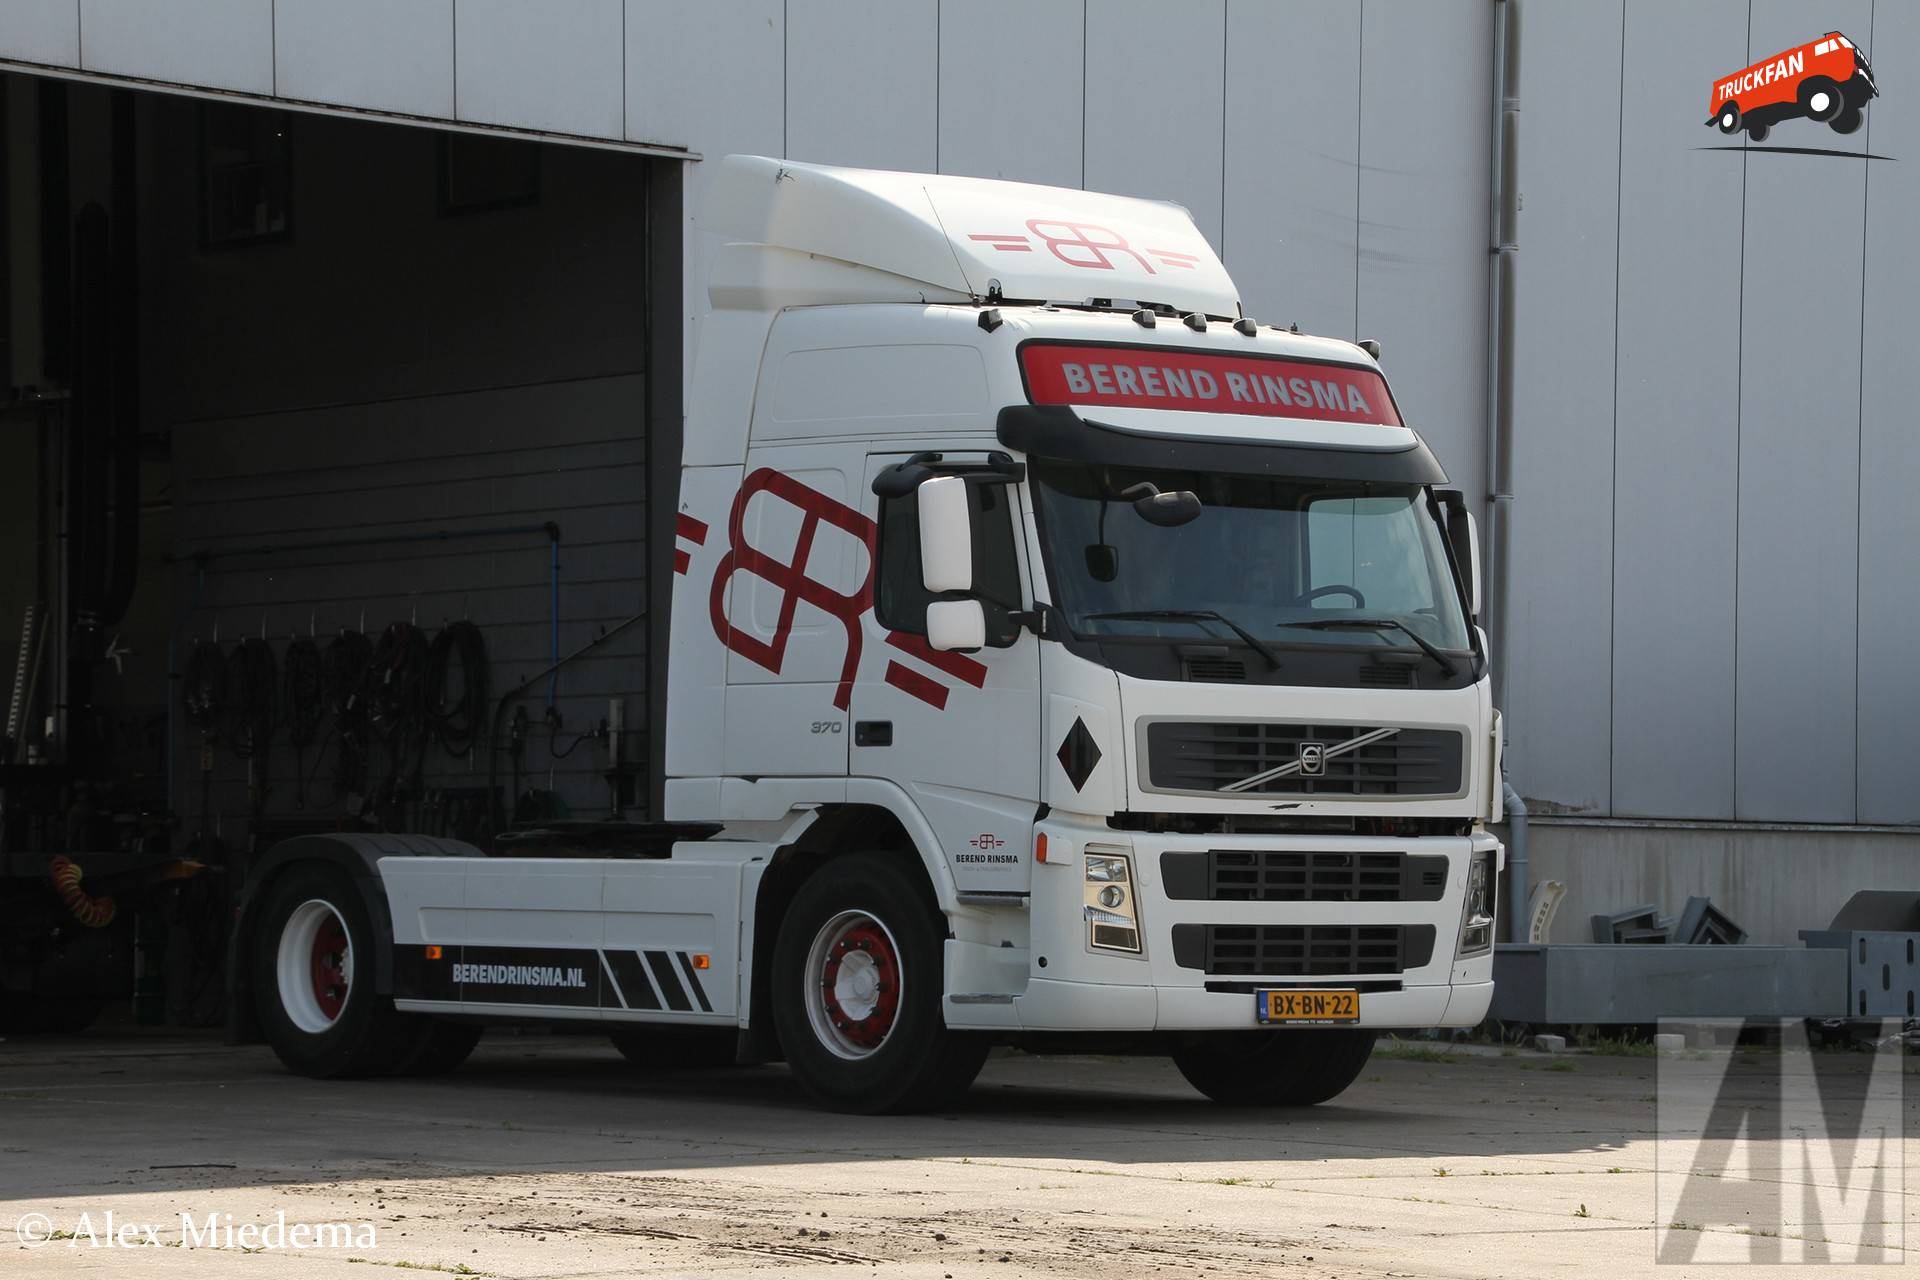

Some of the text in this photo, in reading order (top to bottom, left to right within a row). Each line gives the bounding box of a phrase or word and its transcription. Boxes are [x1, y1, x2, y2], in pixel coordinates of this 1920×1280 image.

[1062, 362, 1373, 415] BEREND RINSMA
[810, 721, 842, 734] 370
[955, 854, 1019, 864] BEREND RINSMA
[452, 963, 587, 988] BERENDRINSMA.NL
[1273, 995, 1353, 1015] BX-BN-22
